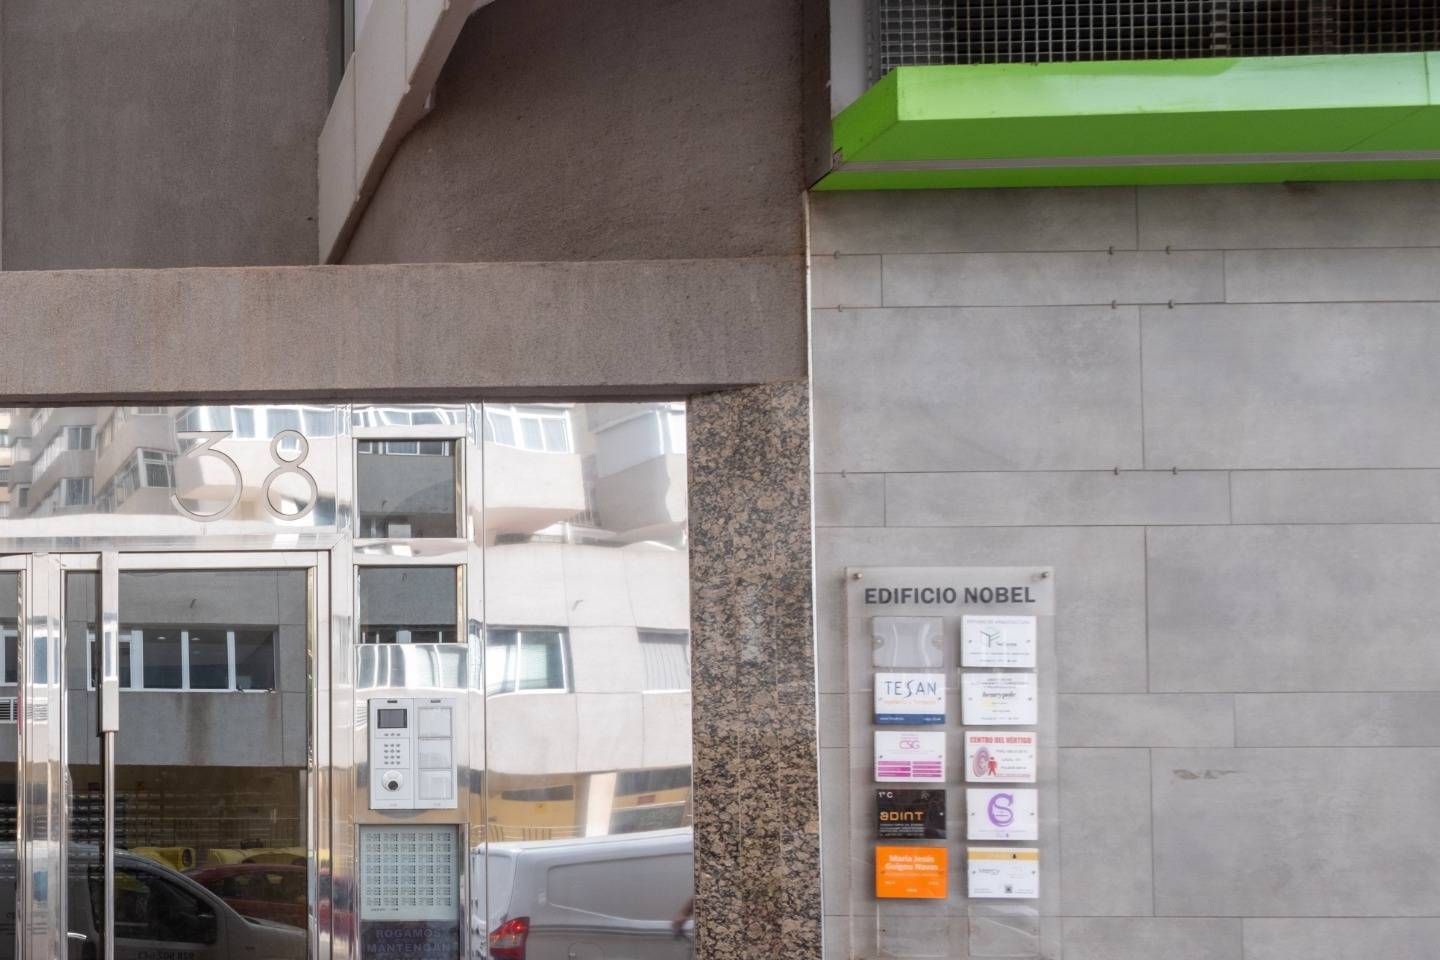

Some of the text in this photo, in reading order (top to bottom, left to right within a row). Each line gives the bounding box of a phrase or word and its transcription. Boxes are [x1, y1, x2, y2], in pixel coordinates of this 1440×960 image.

[171, 429, 319, 523] 38
[864, 586, 1037, 605] EDIFICIO NOBEL
[884, 679, 937, 699] TESAN
[969, 736, 993, 744] CENTRO
[994, 736, 1005, 744] DEL
[886, 791, 894, 799] C
[375, 928, 441, 939] ROGAMOS
[367, 943, 450, 953] MANTENGAN
